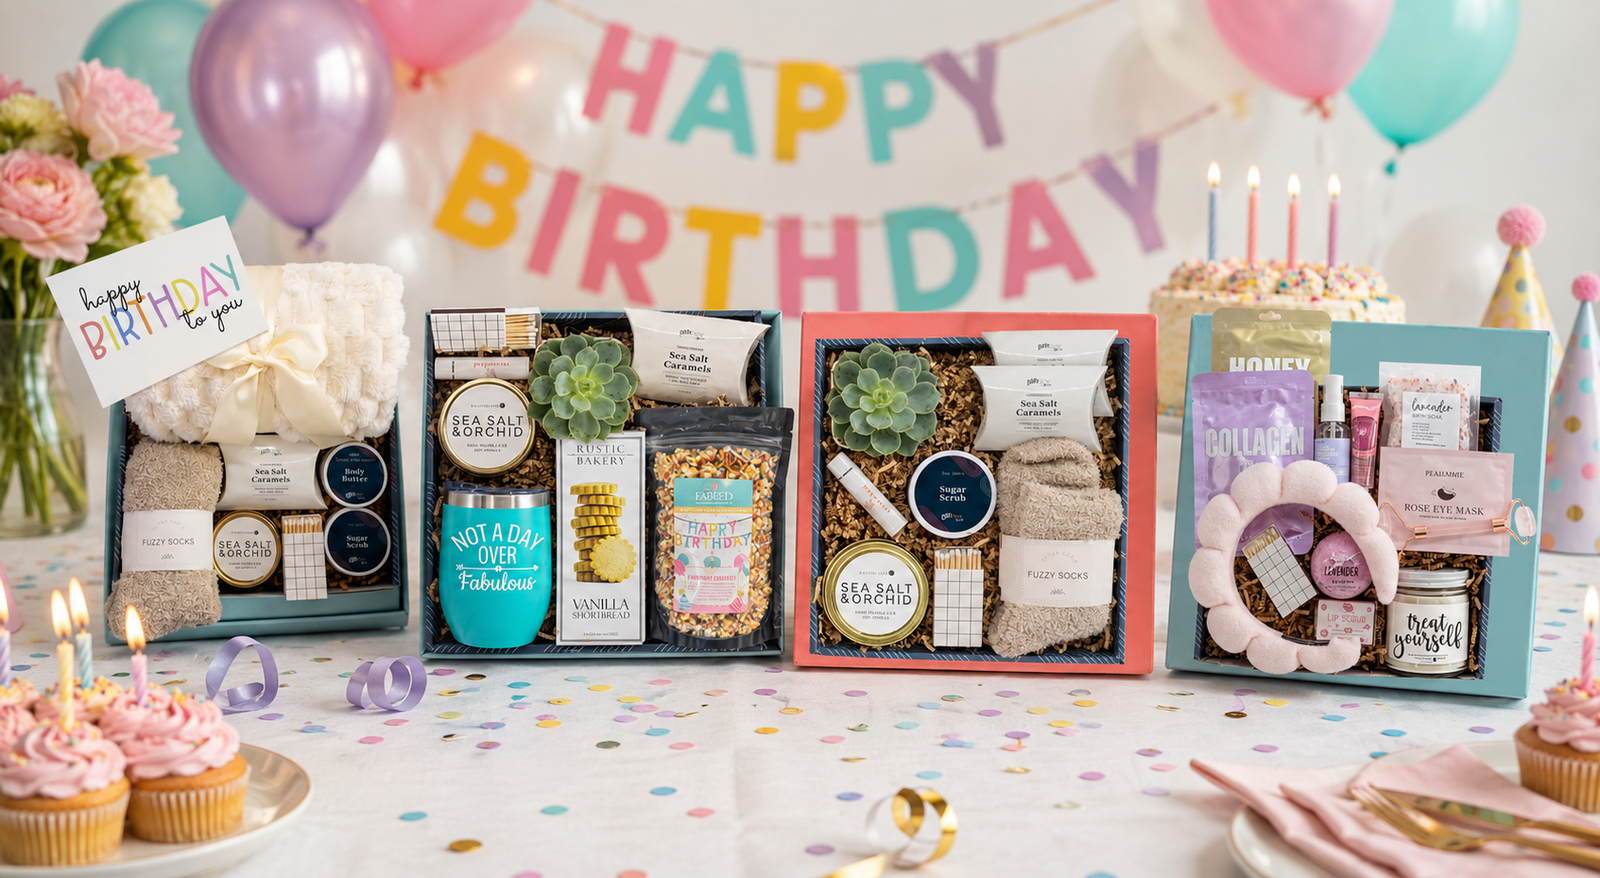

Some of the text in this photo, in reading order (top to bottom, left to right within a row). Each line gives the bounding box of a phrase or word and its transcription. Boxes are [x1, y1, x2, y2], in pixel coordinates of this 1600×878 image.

[582, 21, 1006, 166] HAPPY
[432, 130, 1166, 316] BIRTHDAY
[78, 280, 143, 317] happy
[79, 254, 240, 361] BIRTHDAY
[179, 299, 243, 332] to you
[669, 350, 709, 364] Sea Salt
[663, 360, 712, 374] Caramels
[1229, 356, 1311, 372] HONEY
[1020, 399, 1057, 408] Sea Salt
[1016, 408, 1061, 417] Caramels
[452, 415, 524, 427] SEA SALT
[452, 426, 524, 438] &ORCHID
[1205, 426, 1305, 458] COLLAGEN
[576, 444, 625, 454] RUSTIC
[576, 456, 625, 466] BAKERY
[271, 467, 287, 475] Salt
[939, 485, 967, 495] Sugar
[939, 493, 967, 502] Scrub
[1404, 503, 1484, 516] ROSE EYE MASK
[168, 538, 195, 546] SOCKS
[450, 523, 545, 552] NOT A DAY
[674, 532, 752, 550] BIRTHDAY
[218, 540, 272, 549] SEA SALT
[218, 549, 273, 558] &ORCHID
[478, 545, 517, 565] OVER
[458, 570, 537, 592] Fabulous
[1027, 570, 1089, 580] FUZZY SOCKS
[840, 582, 912, 594] SEA SALT
[572, 598, 630, 610] VANILLA
[840, 593, 912, 606] &ORCHID
[571, 611, 631, 619] SHORTBREAD
[1327, 613, 1339, 622] LIP
[1406, 613, 1448, 634] treat
[1393, 621, 1463, 659] yourself
